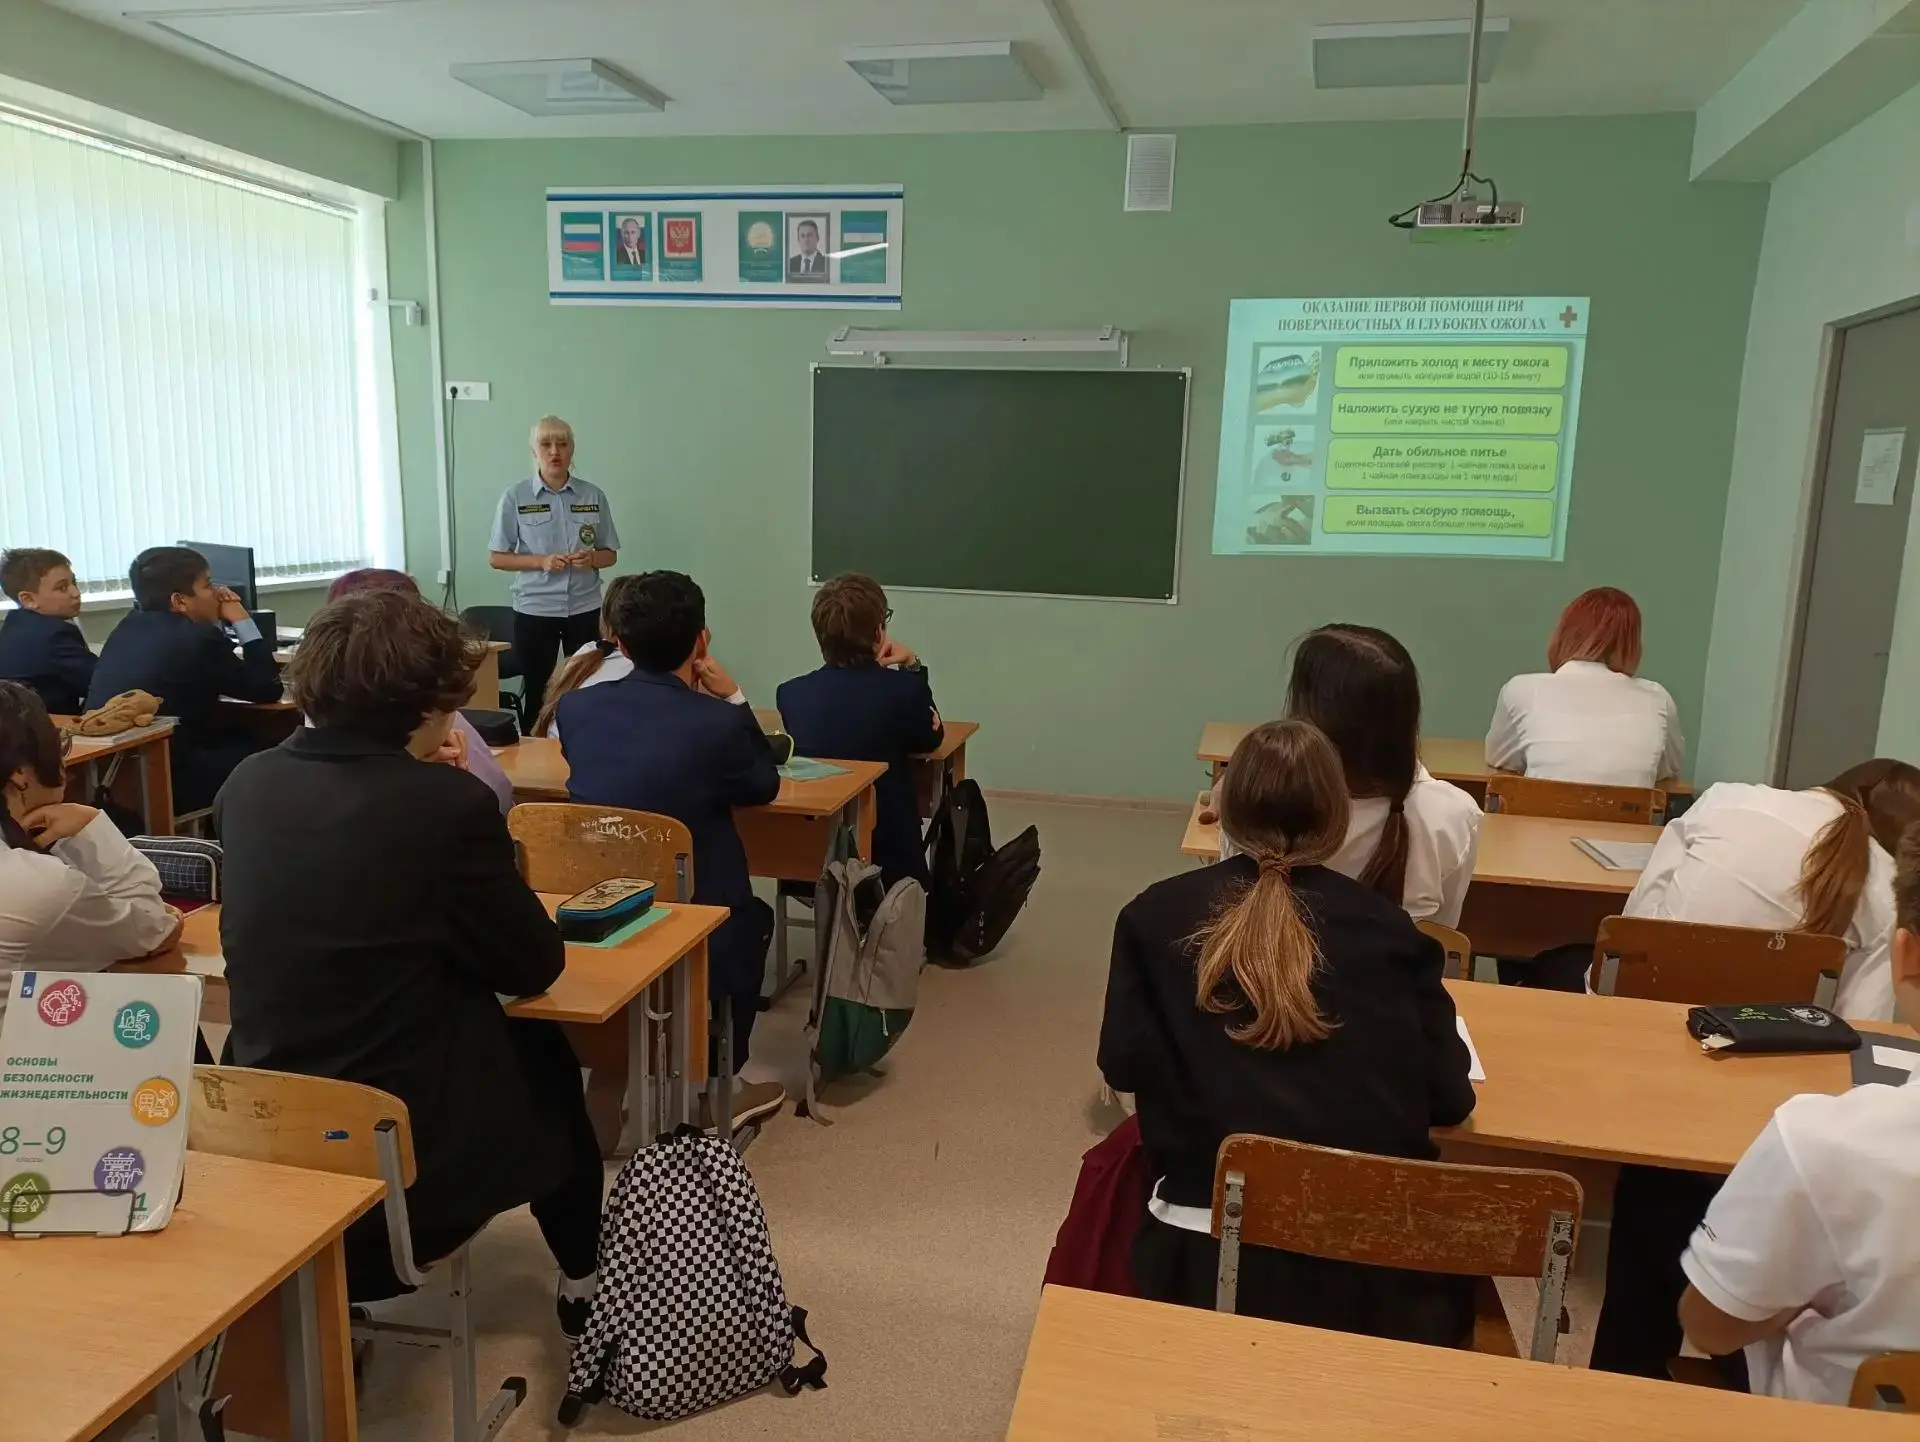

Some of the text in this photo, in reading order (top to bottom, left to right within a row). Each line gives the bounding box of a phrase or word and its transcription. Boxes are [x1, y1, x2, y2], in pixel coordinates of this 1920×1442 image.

[1302, 296, 1524, 314] ОКАЗАНИЕ ПЕРВОЙ ПОМОЩИ ПРИ
[1405, 318, 1417, 330] И
[1420, 317, 1488, 330] ГЛУБОКИХ
[1490, 317, 1547, 330] ОЖОГАХ
[1349, 356, 1550, 370] Приложить холод к месту ожога
[1338, 403, 1552, 418] Наложить сухую не тугую повязку
[1373, 446, 1507, 459] Дать обильное питье
[1356, 504, 1515, 519] Вызвать скорую помощь,
[7, 1057, 58, 1067] ОСНОВЫ
[3, 1073, 94, 1084] БЕЗОПАСНОСТИ
[0, 1090, 129, 1101] ЖИЗНЕДЕЯТЕЛЬНОСТИ
[134, 1192, 148, 1212] 1
